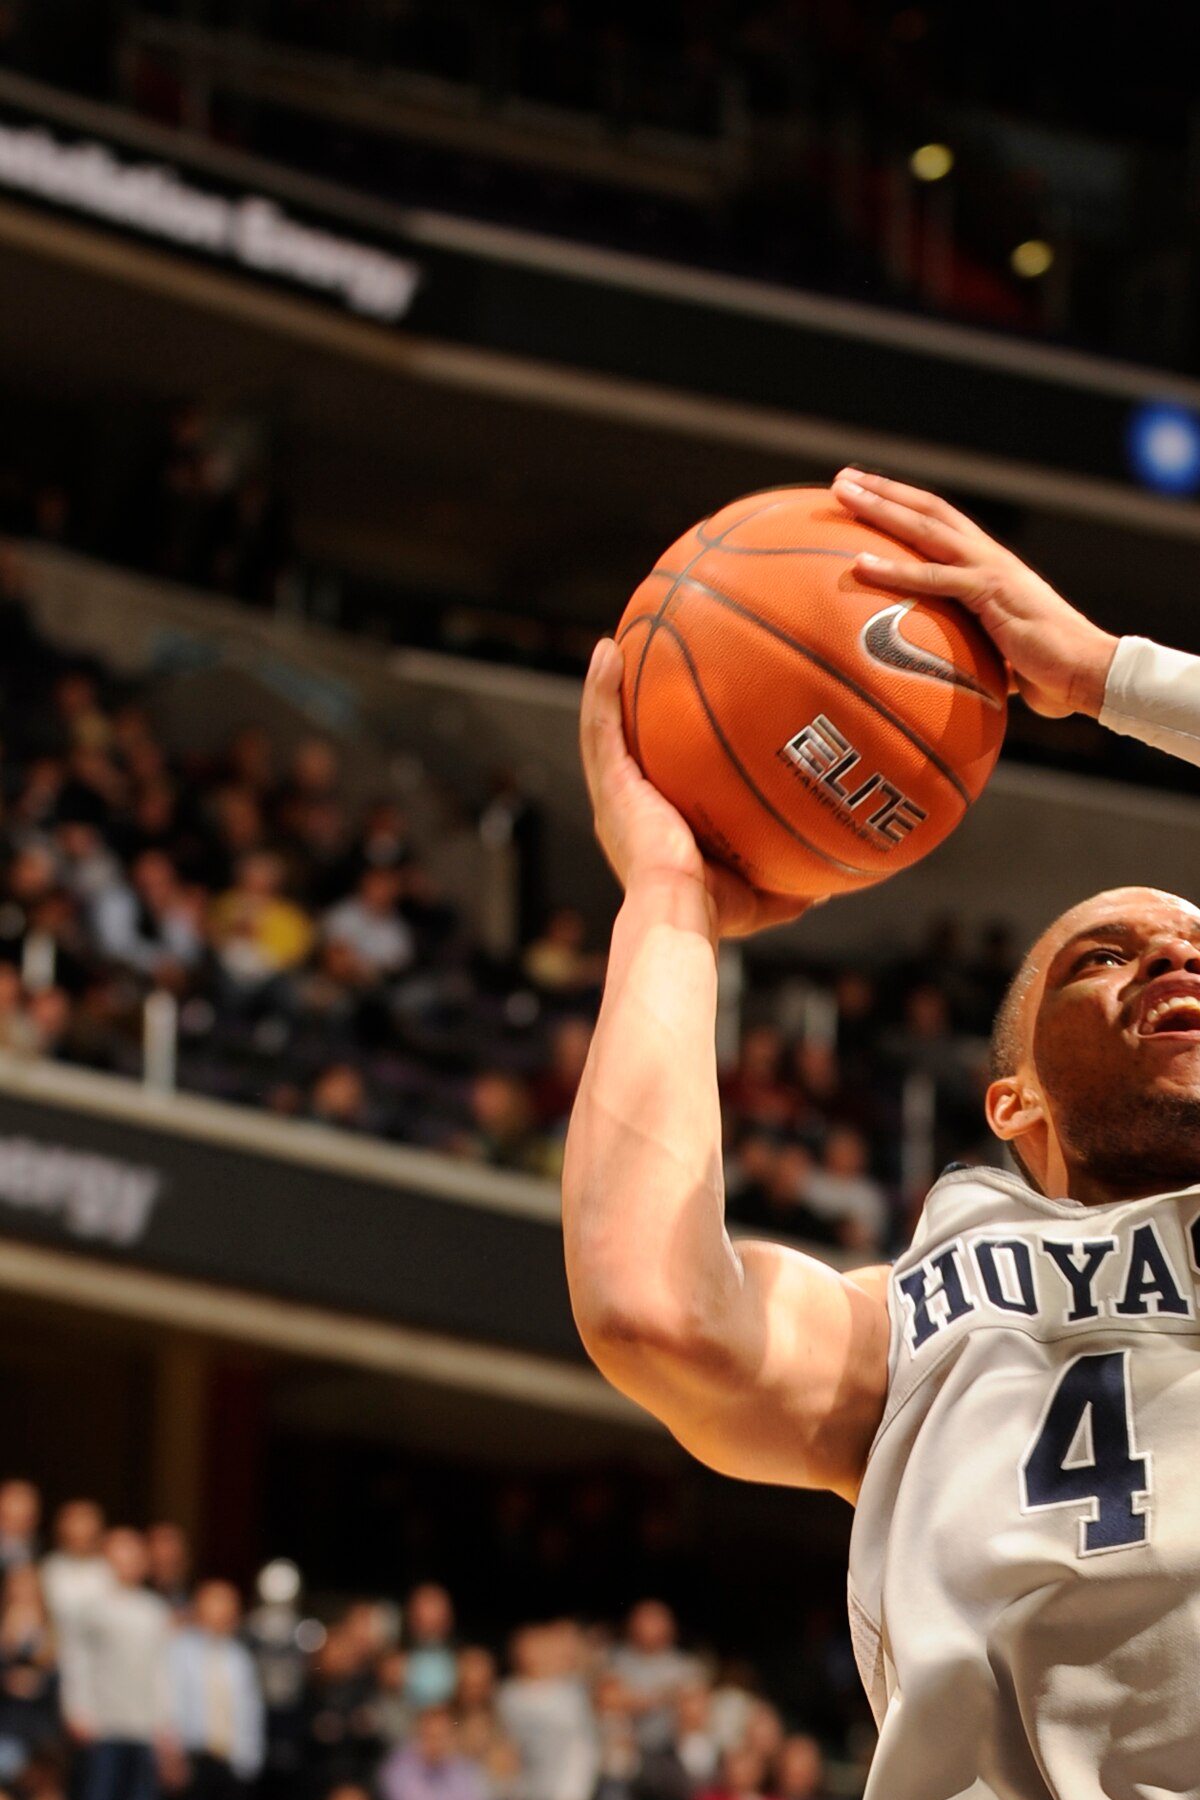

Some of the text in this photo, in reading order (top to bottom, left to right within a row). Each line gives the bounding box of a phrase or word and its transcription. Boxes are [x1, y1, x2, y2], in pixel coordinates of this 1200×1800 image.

[775, 747, 897, 854] CHAMPIONS
[781, 712, 930, 846] ELITE
[1017, 1347, 1153, 1559] 4
